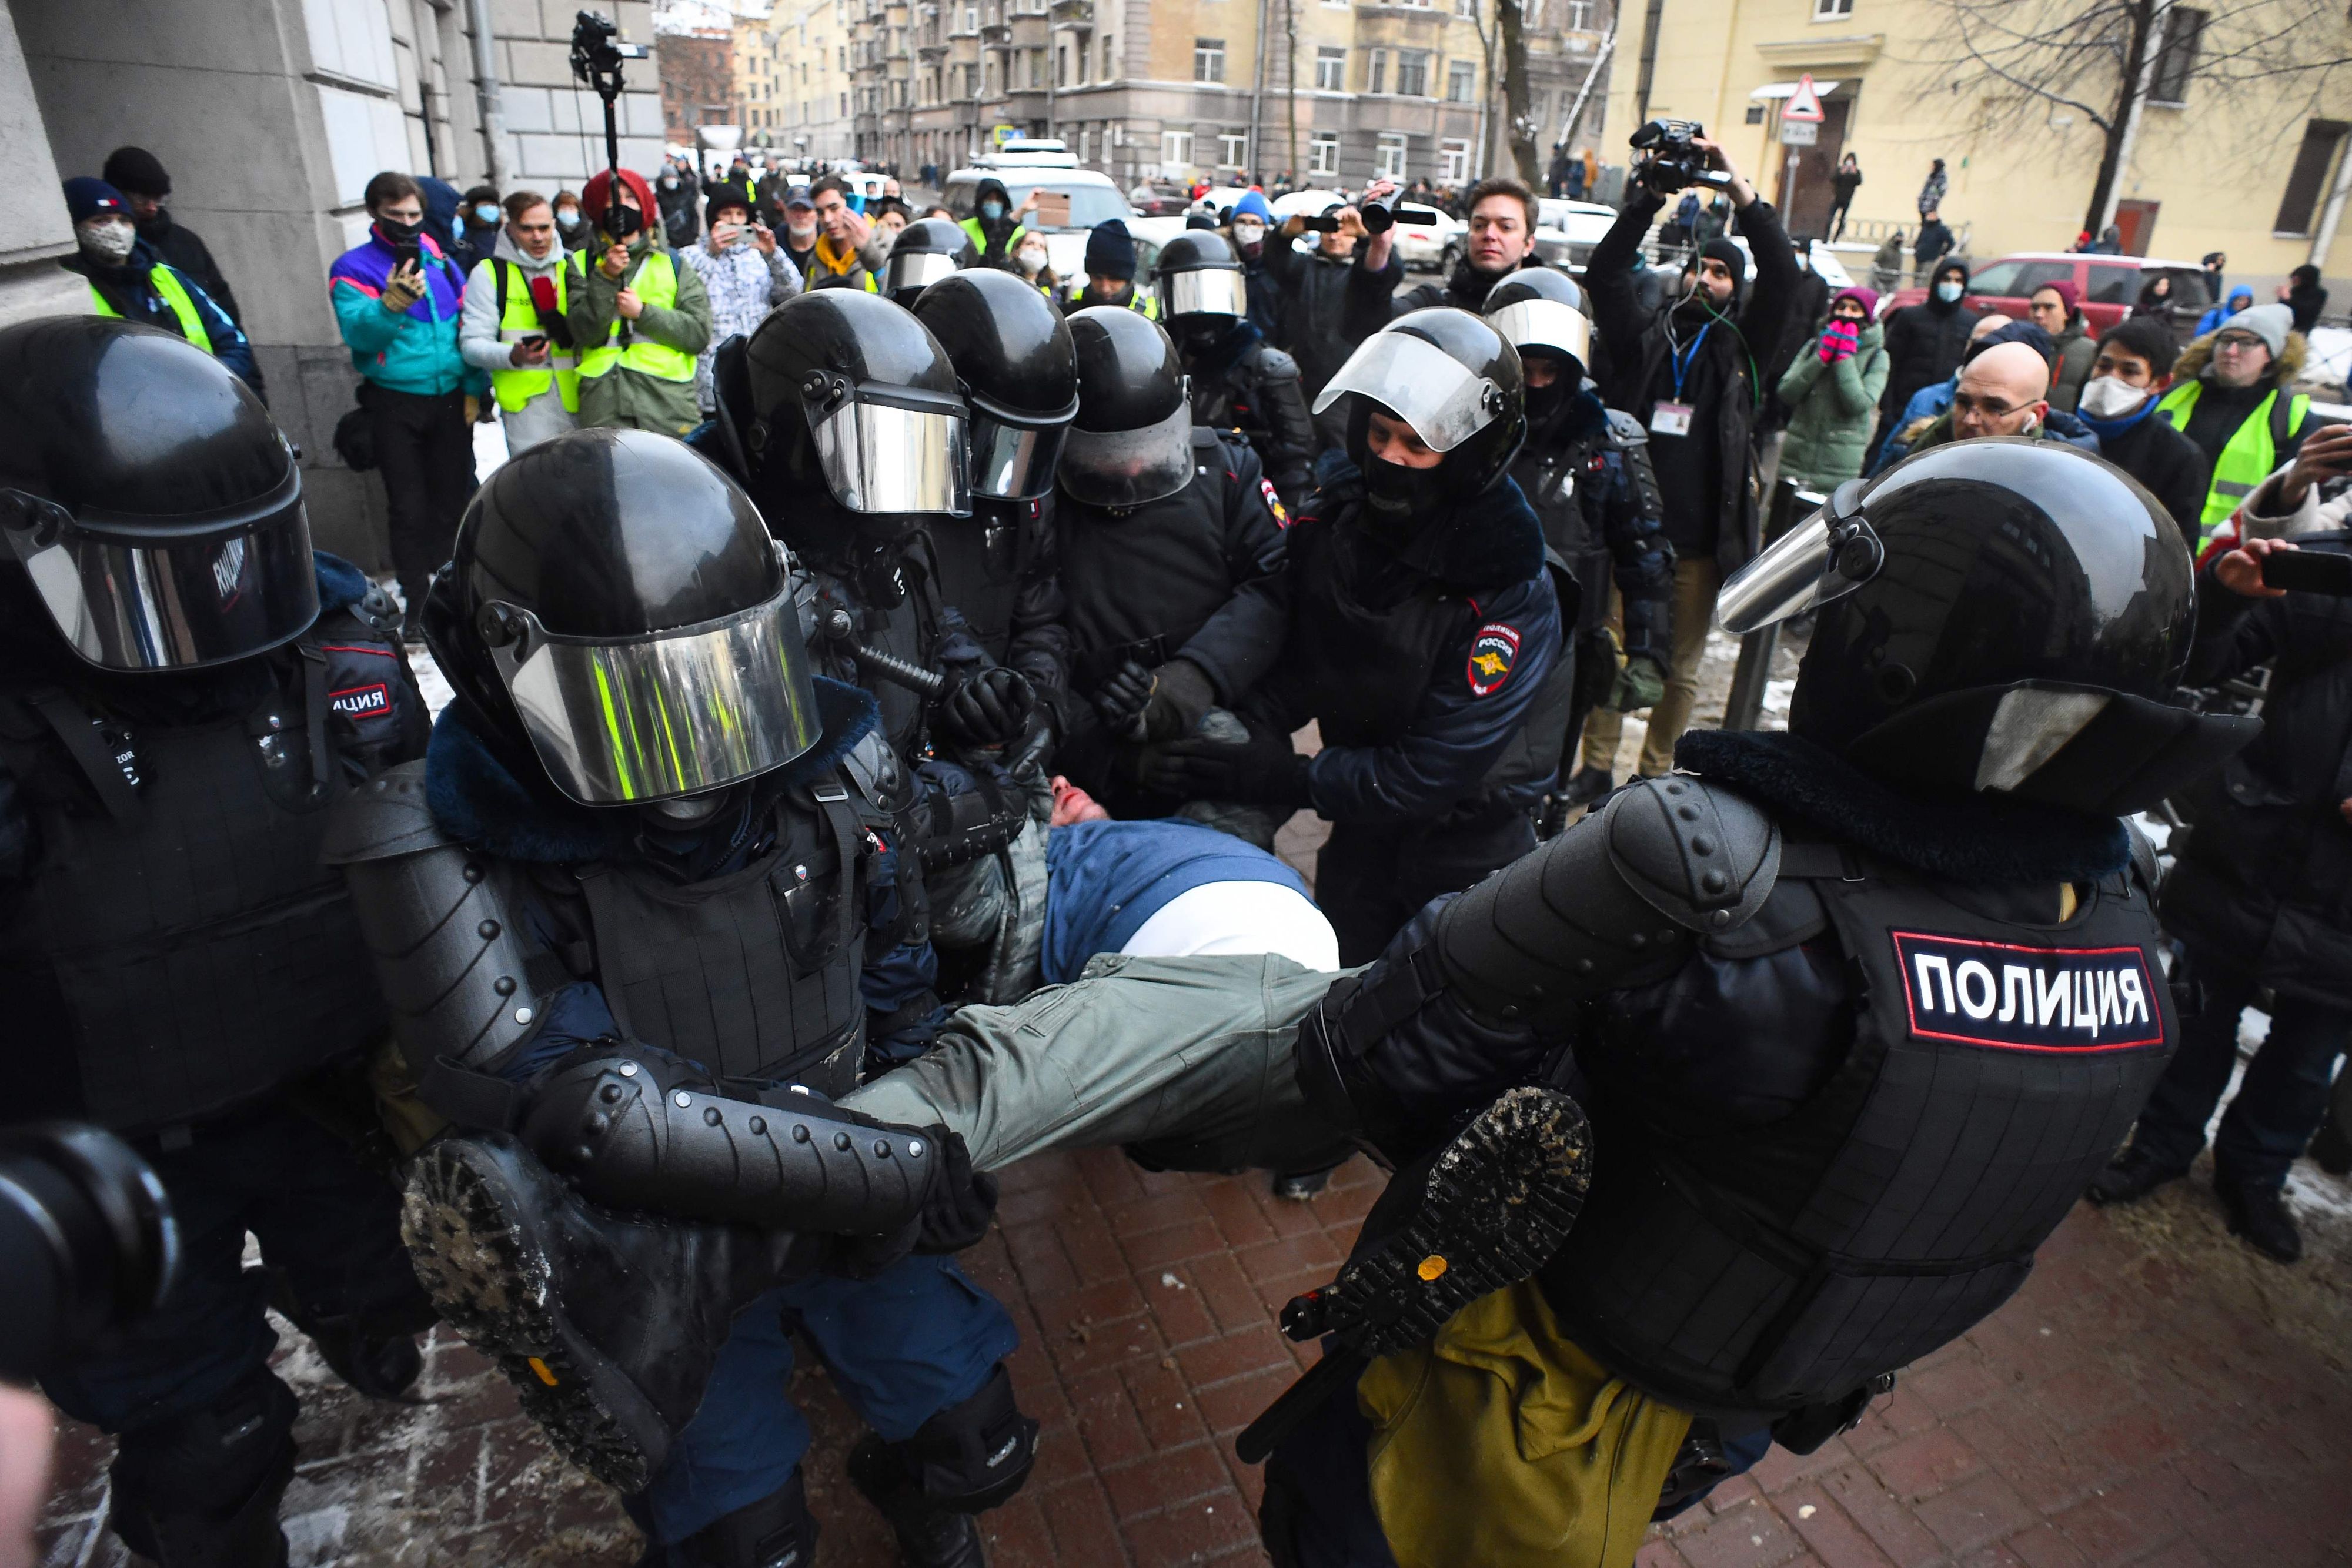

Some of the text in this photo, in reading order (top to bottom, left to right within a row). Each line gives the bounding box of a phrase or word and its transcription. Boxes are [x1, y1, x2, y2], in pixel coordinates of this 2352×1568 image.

[1478, 637, 1514, 657] РОССИЯ
[333, 691, 385, 712] ИЦИЯ
[115, 751, 135, 764] ZOR
[1914, 953, 2149, 1038] ПОЛИЦИЯ
